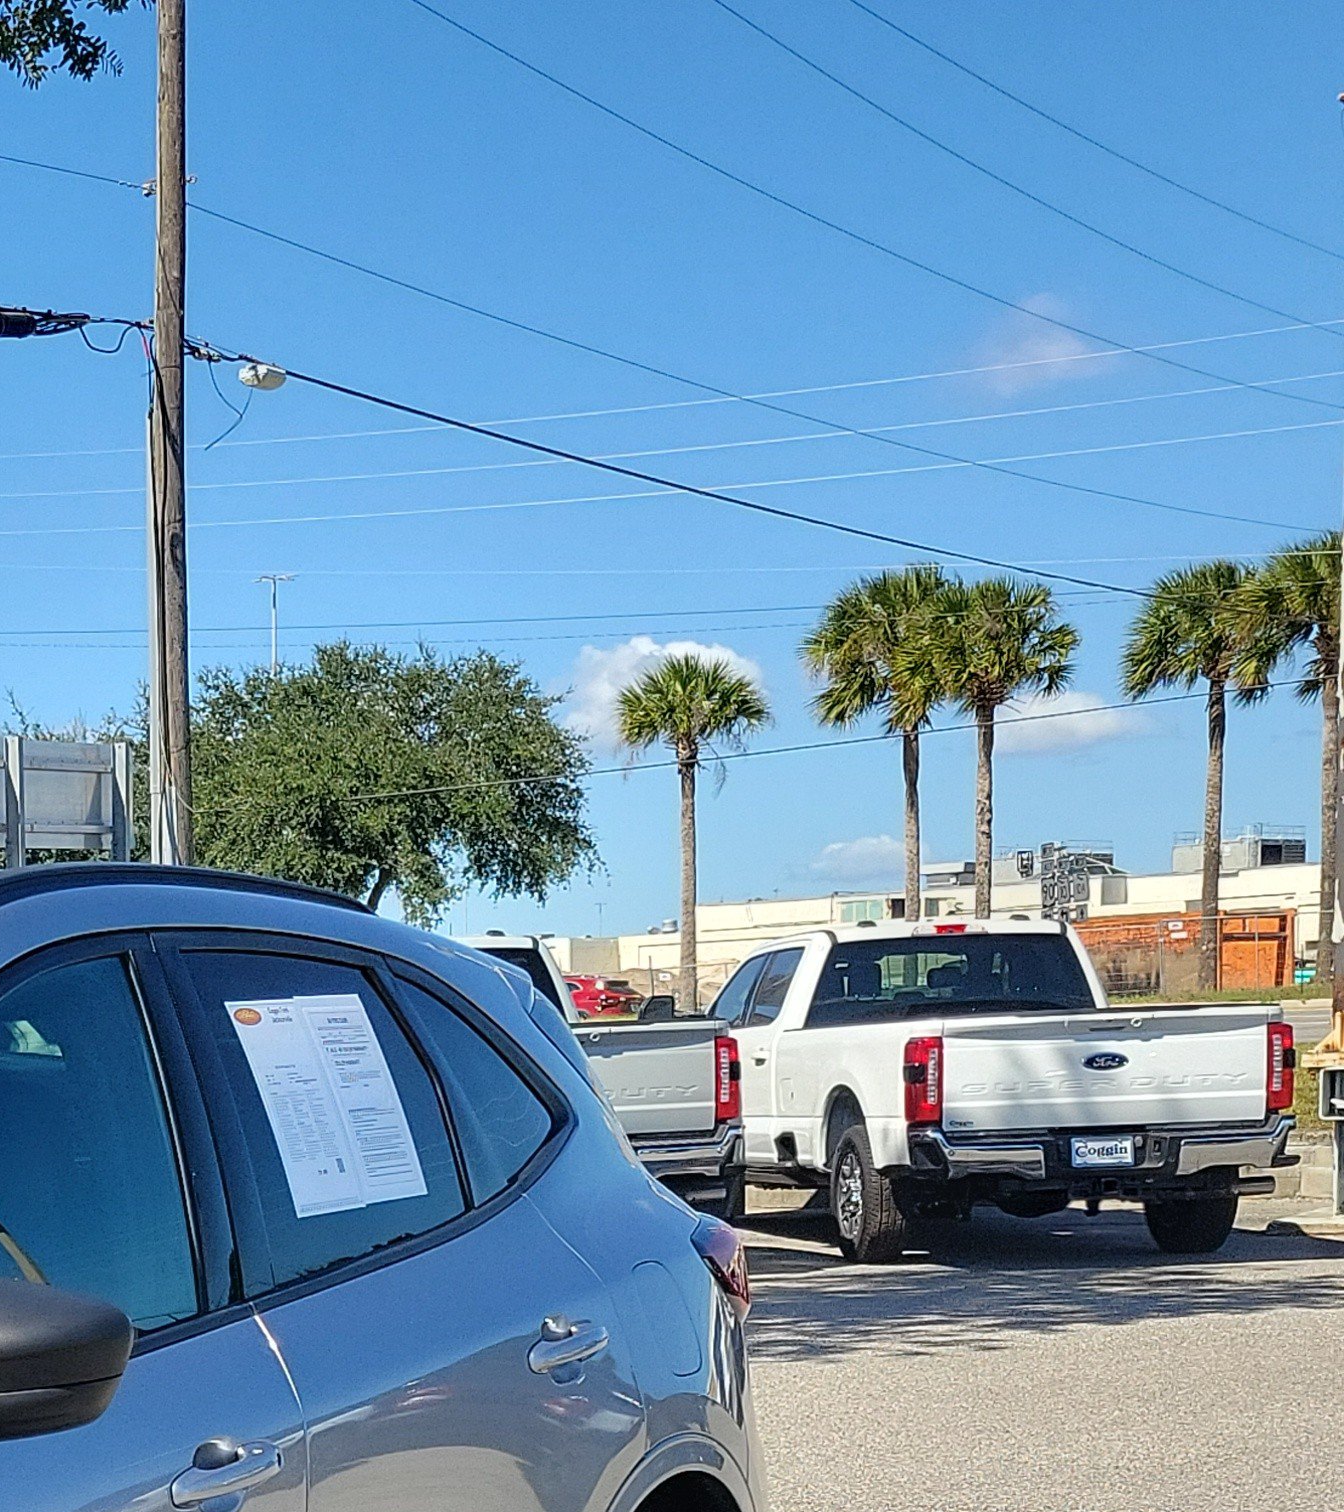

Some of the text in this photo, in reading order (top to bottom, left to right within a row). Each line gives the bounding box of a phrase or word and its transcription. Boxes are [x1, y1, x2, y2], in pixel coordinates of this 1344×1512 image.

[961, 1071, 1249, 1097] SUPER DUTY
[1075, 1143, 1129, 1158] Coggin
